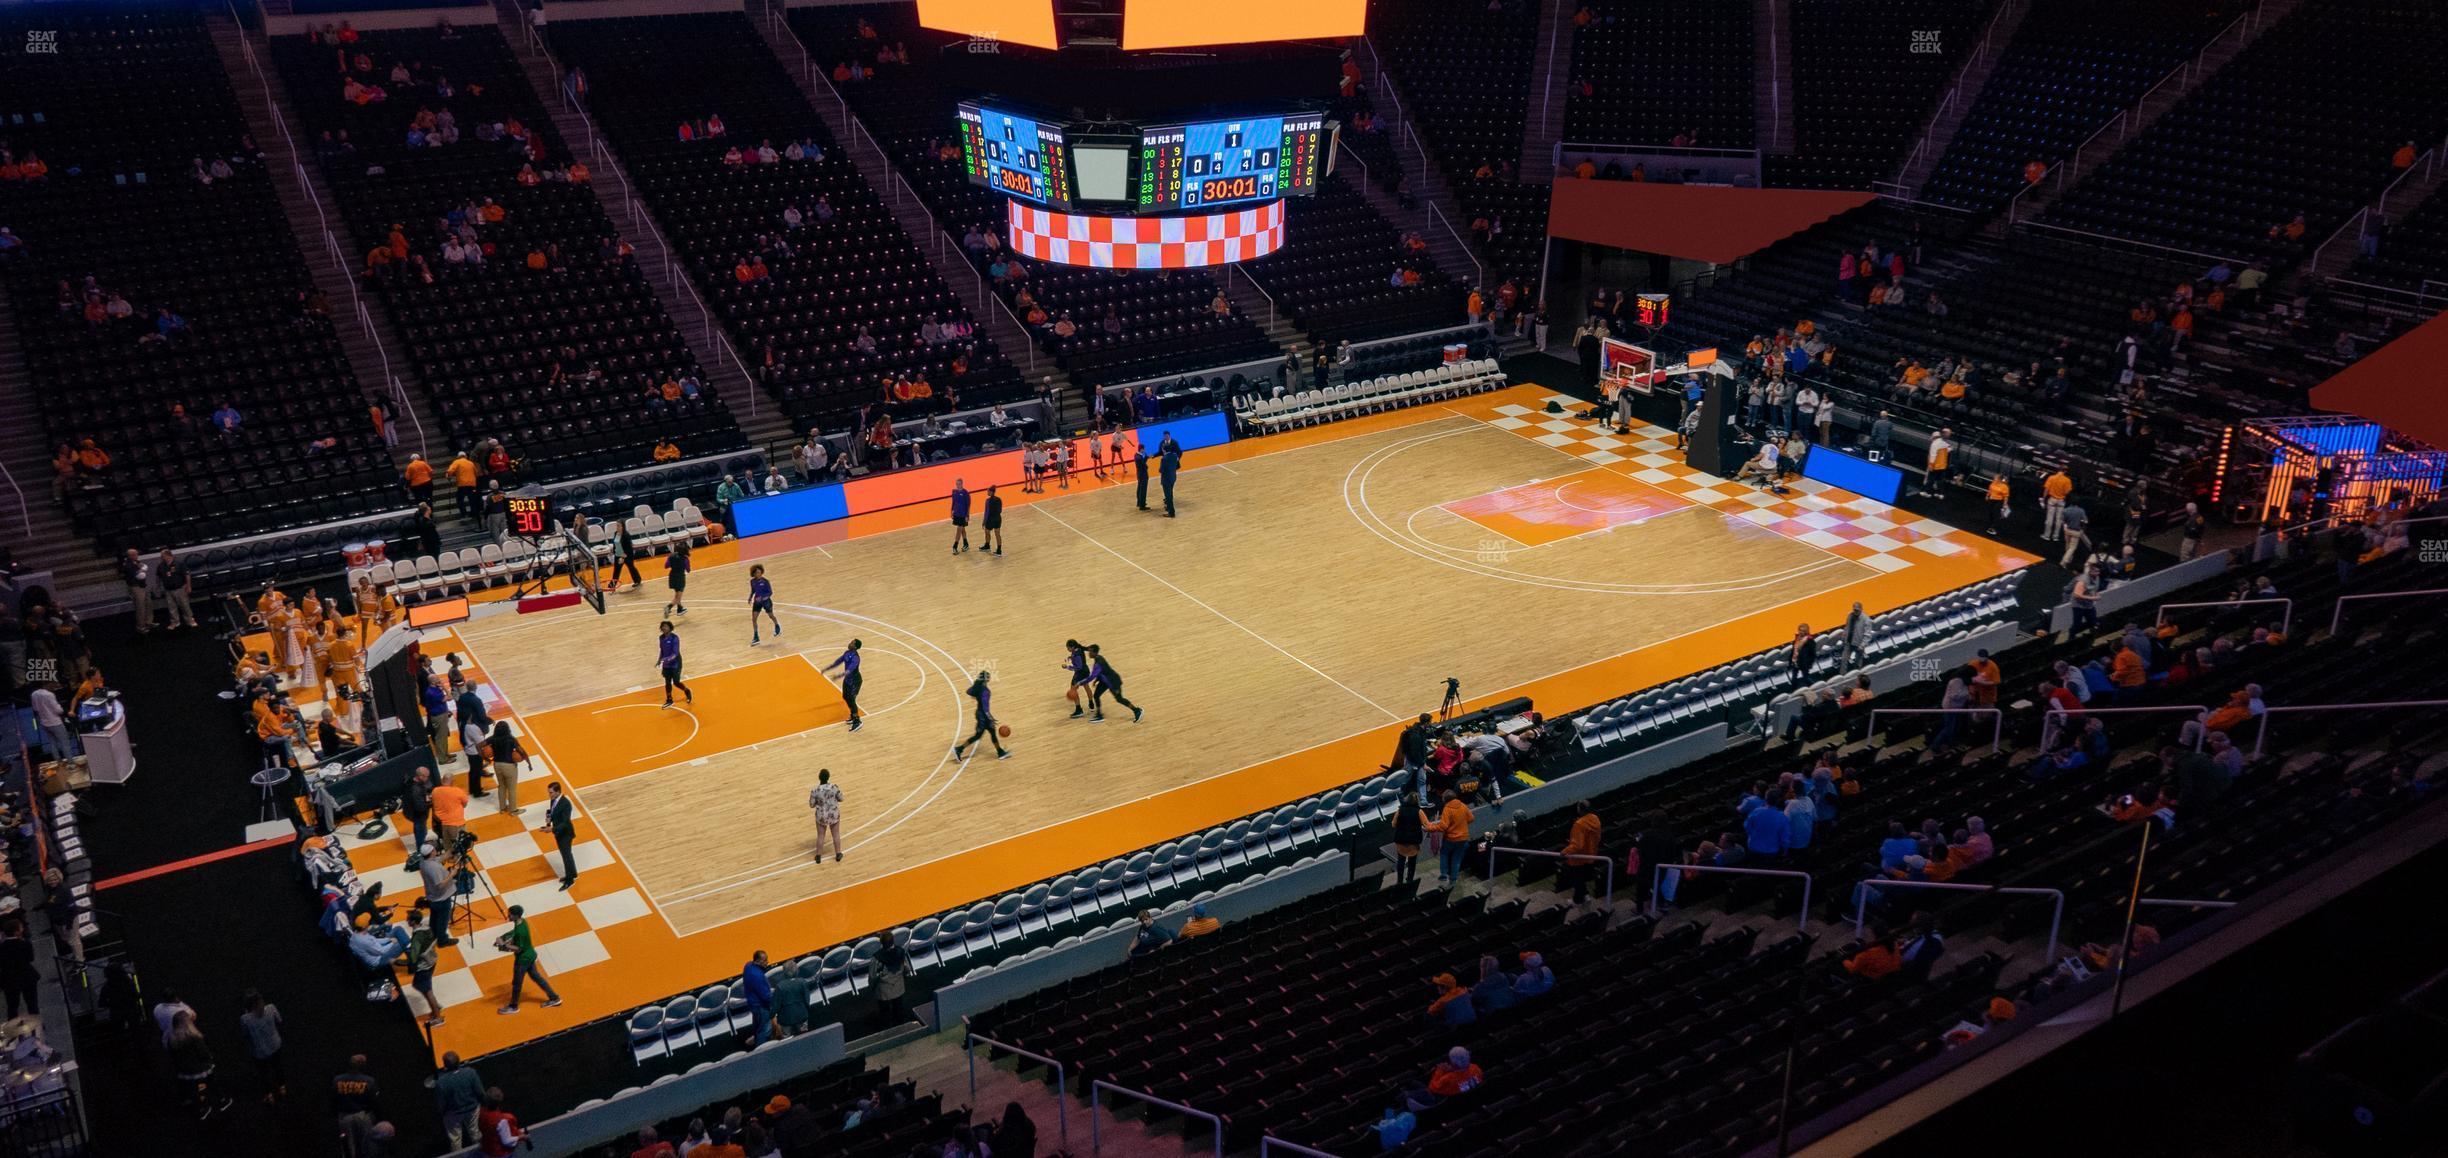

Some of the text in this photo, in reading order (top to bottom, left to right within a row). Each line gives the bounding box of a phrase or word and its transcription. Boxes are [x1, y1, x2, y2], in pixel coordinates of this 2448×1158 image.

[978, 127, 981, 135] 9
[1297, 123, 1307, 131] FLS
[1309, 122, 1321, 130] PTS
[1008, 128, 1012, 140] 1
[1158, 135, 1169, 144] FLS
[1172, 134, 1184, 143] PTS
[1285, 134, 1316, 145] 3 0 0
[978, 138, 984, 146] 17
[1232, 134, 1236, 147] 1
[991, 144, 996, 157] 0
[1041, 144, 1045, 152] 3
[1057, 147, 1061, 156] 0
[1144, 147, 1180, 159] 00 1 9
[1282, 145, 1314, 156] 11 0 7
[1003, 152, 1008, 162] 4
[1020, 157, 1024, 166] 4
[1030, 154, 1036, 168] 0
[1042, 154, 1062, 167] 11 0 7
[1262, 152, 1269, 166] 0
[1281, 156, 1314, 167] 20 2 7
[981, 160, 988, 168] 10
[1146, 162, 1151, 170] 1
[1172, 158, 1182, 167] 17
[1194, 159, 1202, 174] 0
[1215, 163, 1221, 172] 4
[1242, 160, 1248, 169] 4
[984, 170, 988, 178] 0
[1043, 165, 1064, 178] 20 2 7
[1144, 170, 1178, 181] 13 1 8
[1280, 167, 1312, 178] 21 1 2
[994, 175, 998, 185] 0
[1000, 169, 1033, 195] 30:01
[1263, 174, 1274, 182] FLS
[1278, 177, 1312, 189] 24 0 0
[1044, 178, 1051, 186] 21
[1062, 181, 1066, 190] 2
[1142, 184, 1153, 193] 23
[1170, 181, 1180, 190] 10
[1187, 182, 1198, 191] FLS
[1204, 177, 1256, 200] 30:01
[1262, 185, 1269, 194] 0
[1036, 188, 1041, 197] 0
[1046, 188, 1053, 197] 24
[1063, 193, 1068, 201] 0
[1141, 192, 1177, 204] 33 0 0
[1188, 193, 1195, 203] 0
[1640, 308, 1652, 324] 30
[510, 500, 544, 512] 30:01
[516, 512, 542, 531] 30
[337, 1080, 368, 1089] EVENT
